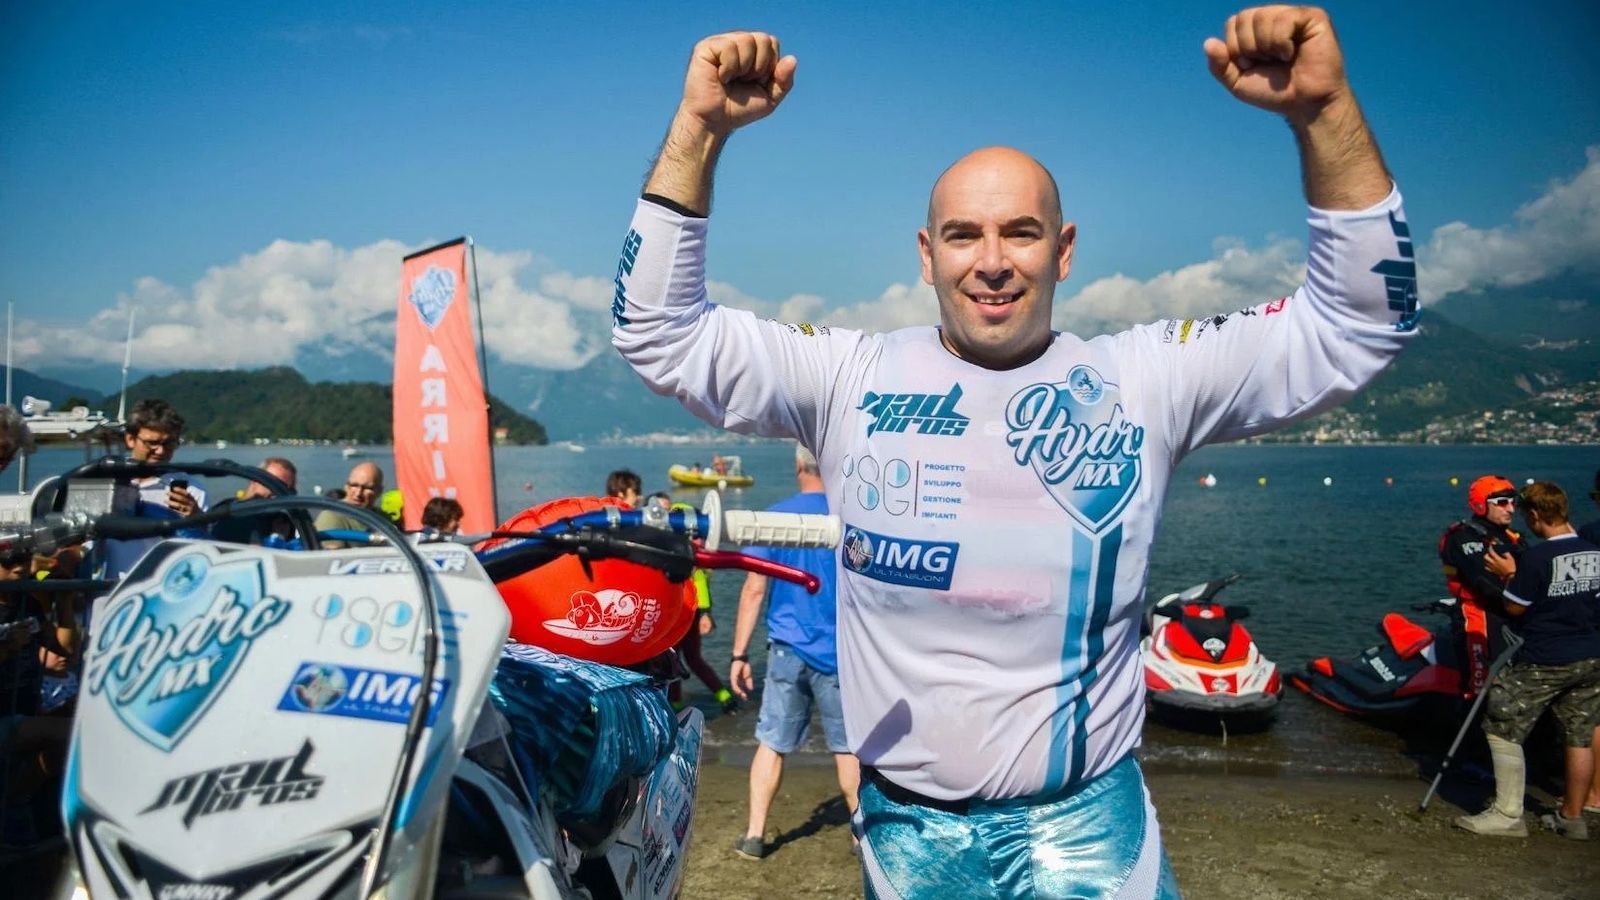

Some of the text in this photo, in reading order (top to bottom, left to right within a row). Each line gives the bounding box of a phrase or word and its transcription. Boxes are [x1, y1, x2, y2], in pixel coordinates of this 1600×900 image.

[923, 463, 966, 472] PROGETTO
[1073, 462, 1127, 490] MX
[923, 479, 962, 488] SVILUPPO
[922, 495, 961, 504] GESTIONE
[921, 511, 957, 520] IMPIANTI
[874, 539, 952, 573] IMG
[86, 582, 292, 706] Hydro
[151, 656, 223, 704] MX
